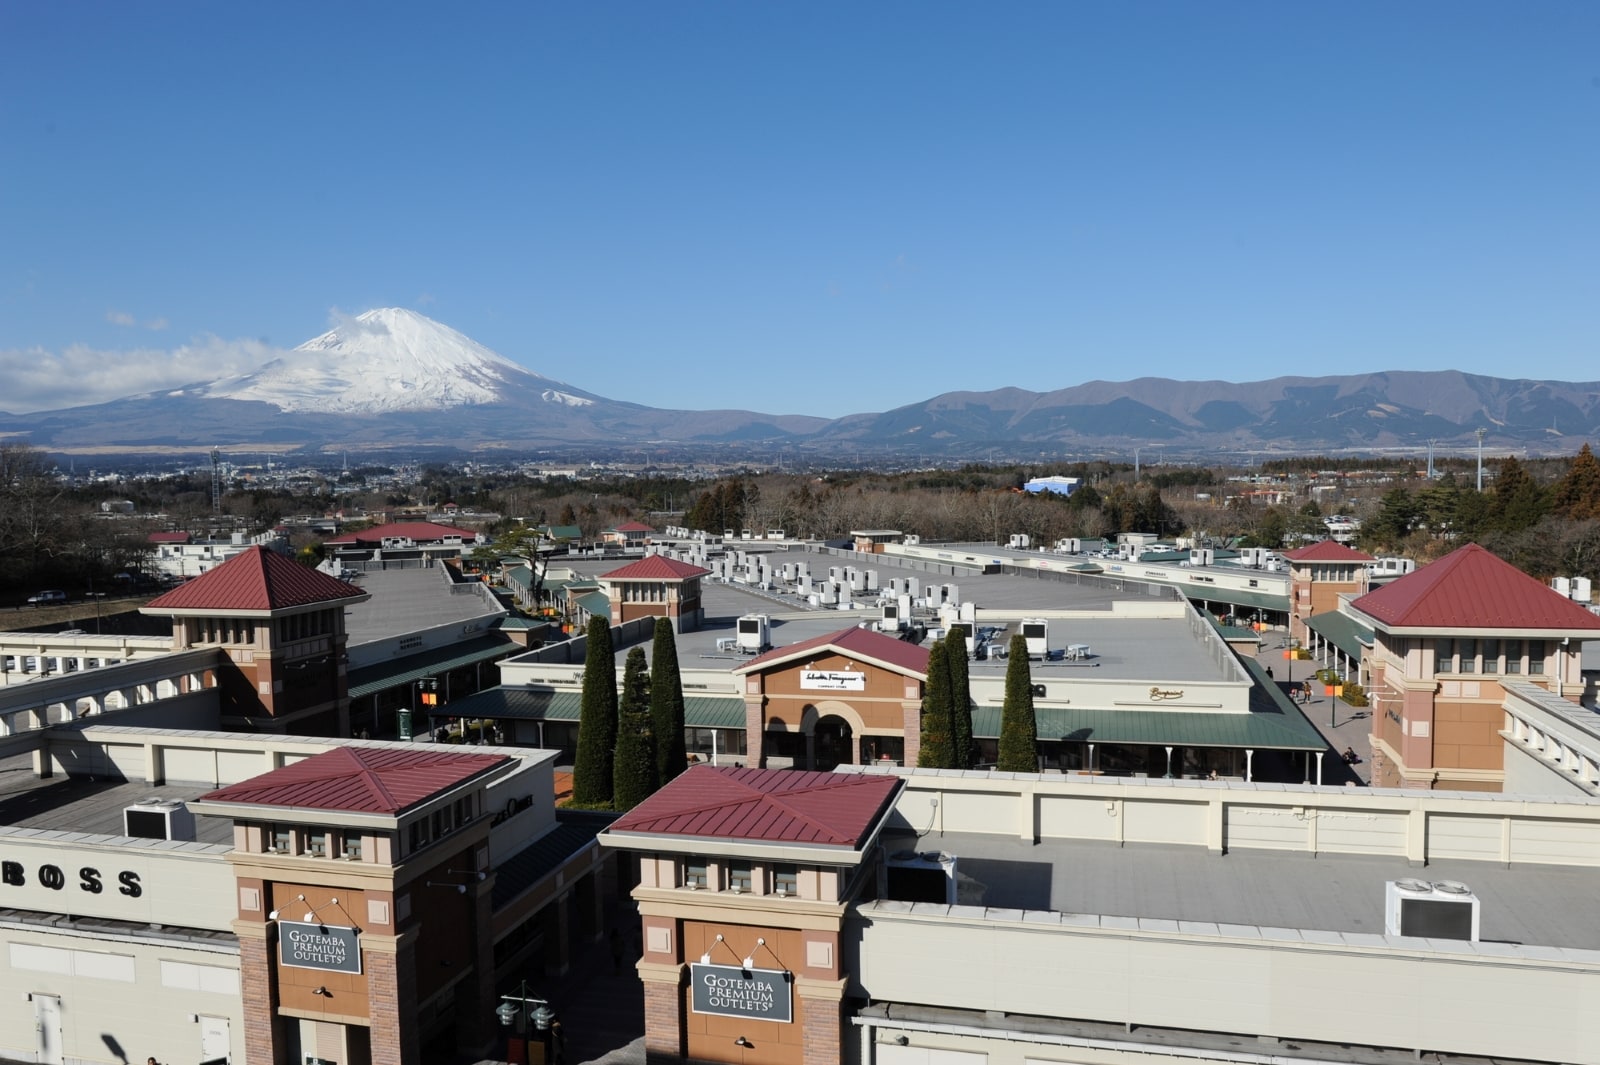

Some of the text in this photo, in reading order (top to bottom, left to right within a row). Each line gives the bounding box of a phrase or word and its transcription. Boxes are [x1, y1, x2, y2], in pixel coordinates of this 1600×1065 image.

[2, 860, 142, 898] BOSS
[289, 930, 346, 947] GOTEMBA
[293, 942, 346, 956] PREMIUM
[704, 974, 774, 993] GOTEMBA
[709, 987, 774, 1003] PREMIUM
